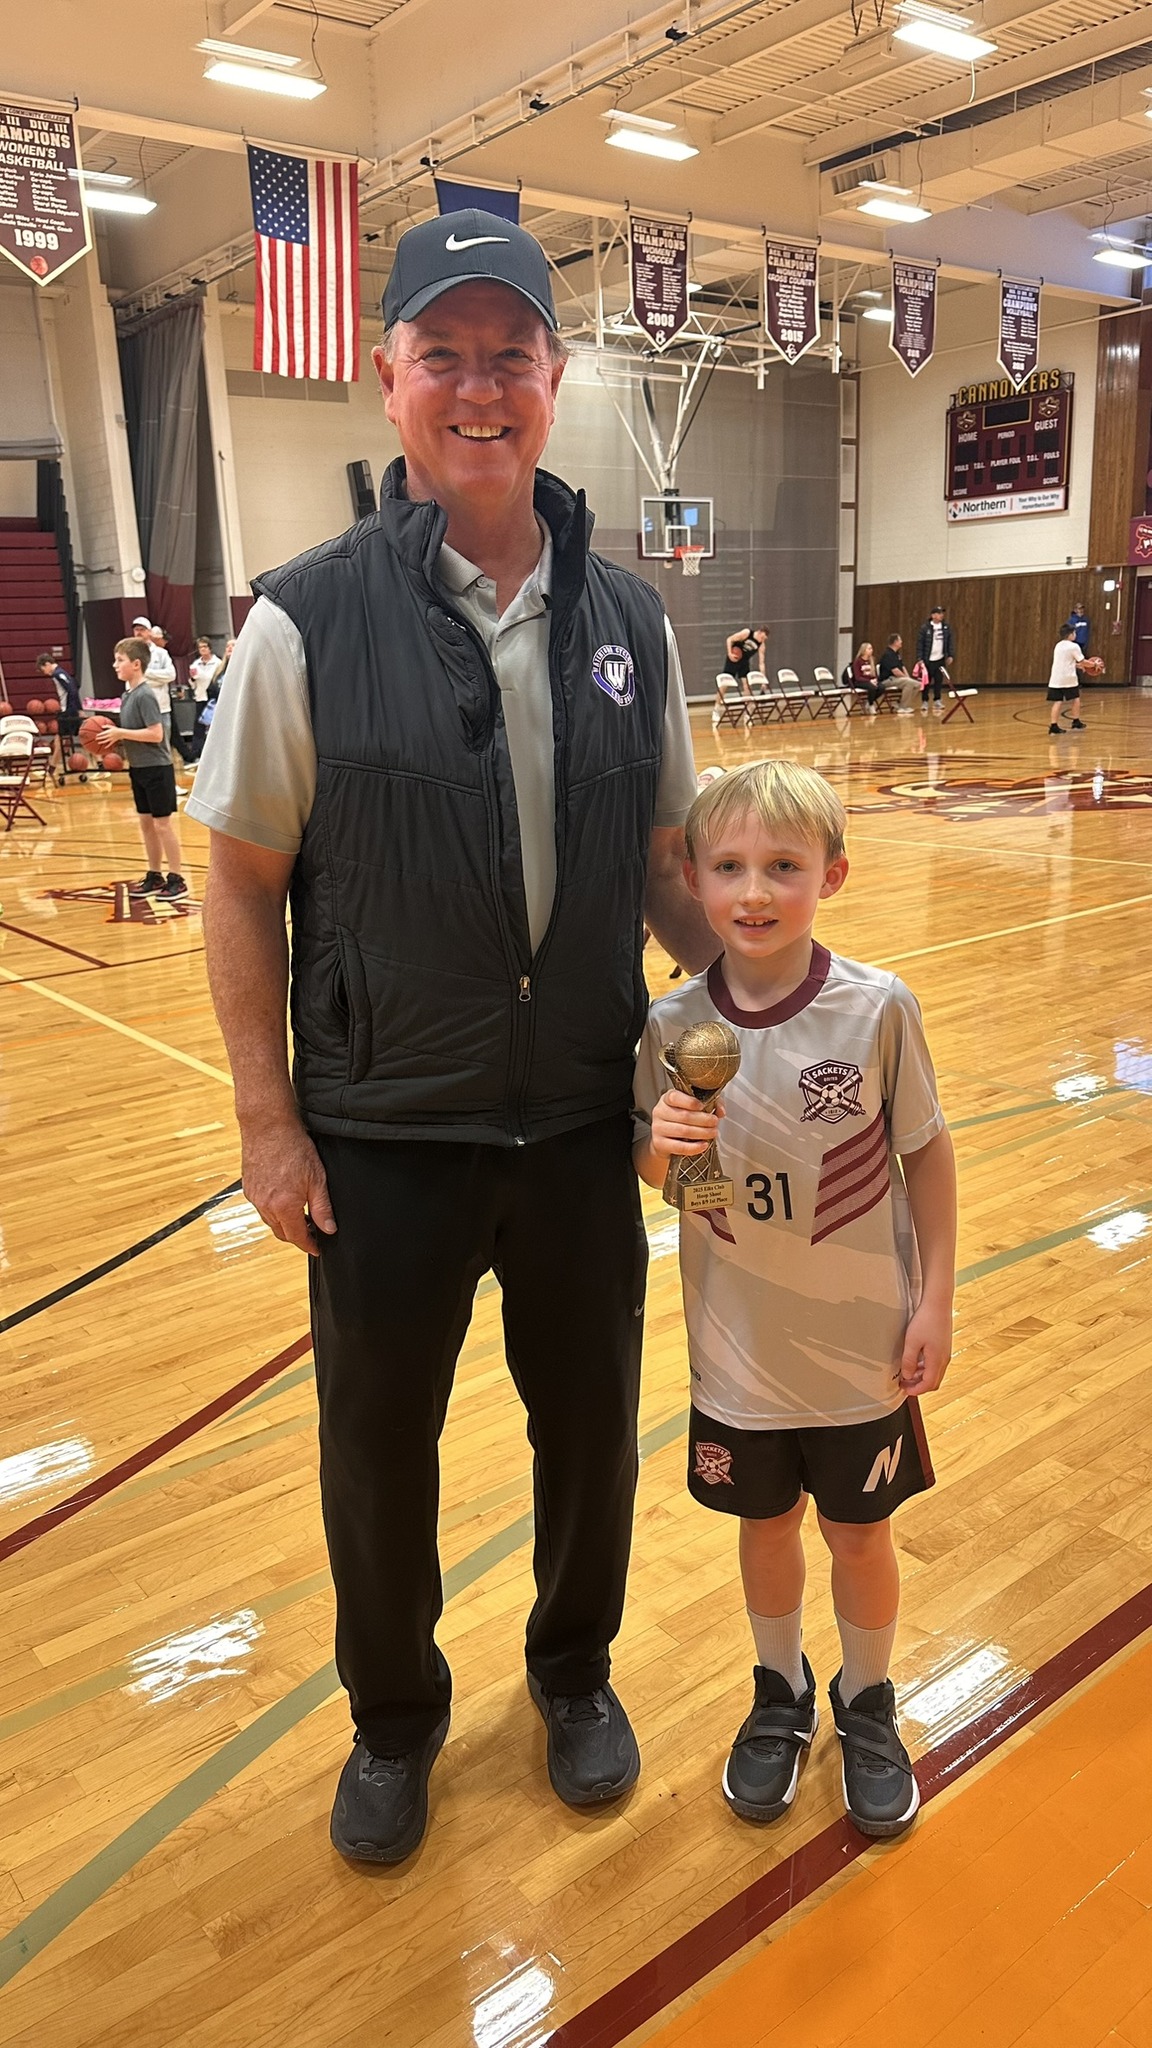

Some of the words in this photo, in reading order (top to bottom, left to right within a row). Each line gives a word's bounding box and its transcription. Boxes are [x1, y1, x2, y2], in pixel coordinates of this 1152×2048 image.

[29, 119, 53, 131] DIV.
[54, 123, 68, 133] III
[0, 125, 70, 149] AMPIONS
[0, 141, 56, 159] WOMEN'S
[0, 153, 66, 172] ASKETBALL
[14, 228, 59, 250] 1999
[633, 232, 686, 251] CHAMPIONS
[642, 245, 677, 258] WOMEN'S
[645, 254, 675, 266] SOCCER
[768, 255, 815, 272] CHAMPIONS
[768, 273, 788, 283] CROSS
[789, 277, 816, 287] COUNTRY
[776, 267, 808, 279] WOMEN'S
[895, 276, 934, 292] CHAMPIONS
[899, 286, 930, 298] VOLLEYBALL
[1003, 298, 1037, 312] CHAMPIONS
[646, 312, 675, 328] 2008
[1006, 308, 1034, 318] VOLLEYBALL
[780, 328, 804, 343] 2015
[1034, 418, 1059, 431] GUEST
[958, 431, 978, 443] HOME
[997, 430, 1016, 439] PERIOD
[1043, 451, 1060, 459] FOULS
[954, 464, 969, 472] FOULS
[990, 459, 1008, 467] PLAYER
[1042, 476, 1059, 485] SCORE
[963, 499, 1007, 513] Northern
[606, 663, 626, 690] W
[811, 1066, 848, 1079] SACKETS
[745, 1172, 793, 1221] 31
[700, 1445, 725, 1455] SACKETS
